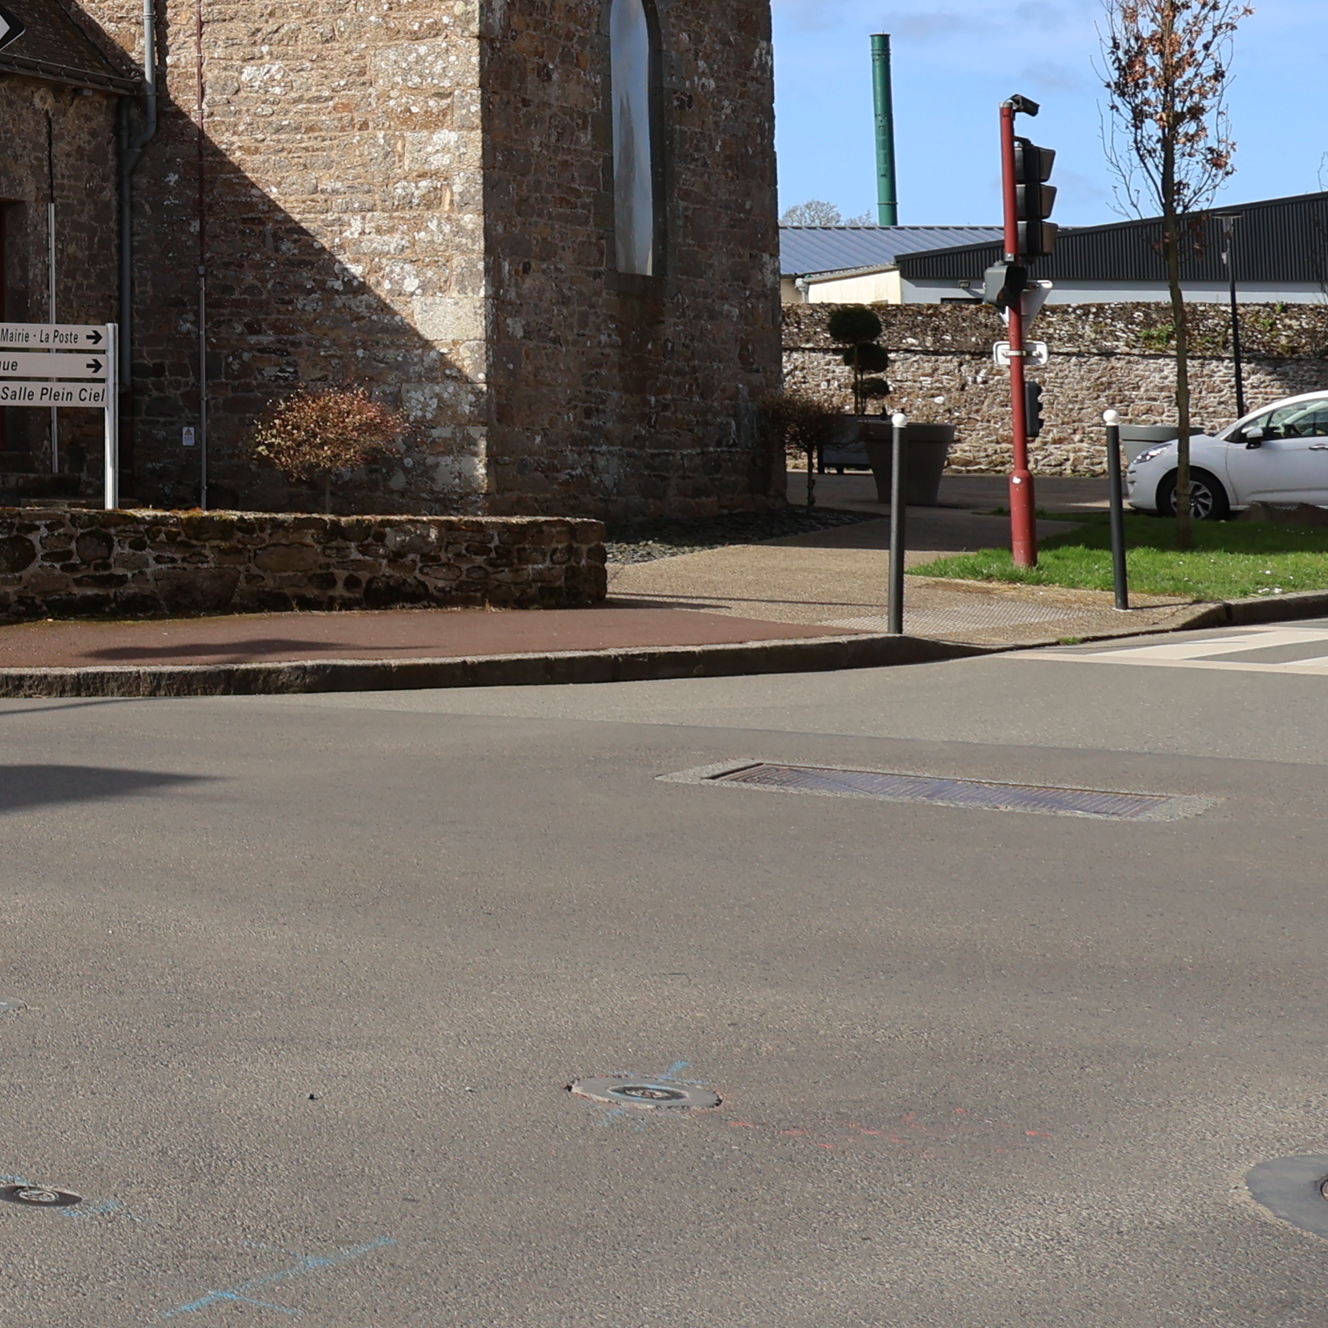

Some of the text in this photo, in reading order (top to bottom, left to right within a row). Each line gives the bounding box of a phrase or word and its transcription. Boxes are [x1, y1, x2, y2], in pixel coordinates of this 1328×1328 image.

[0, 328, 30, 343] Mairie
[39, 329, 50, 343] La
[52, 329, 79, 344] Poste
[0, 386, 106, 402] Salle Plein Ciel
